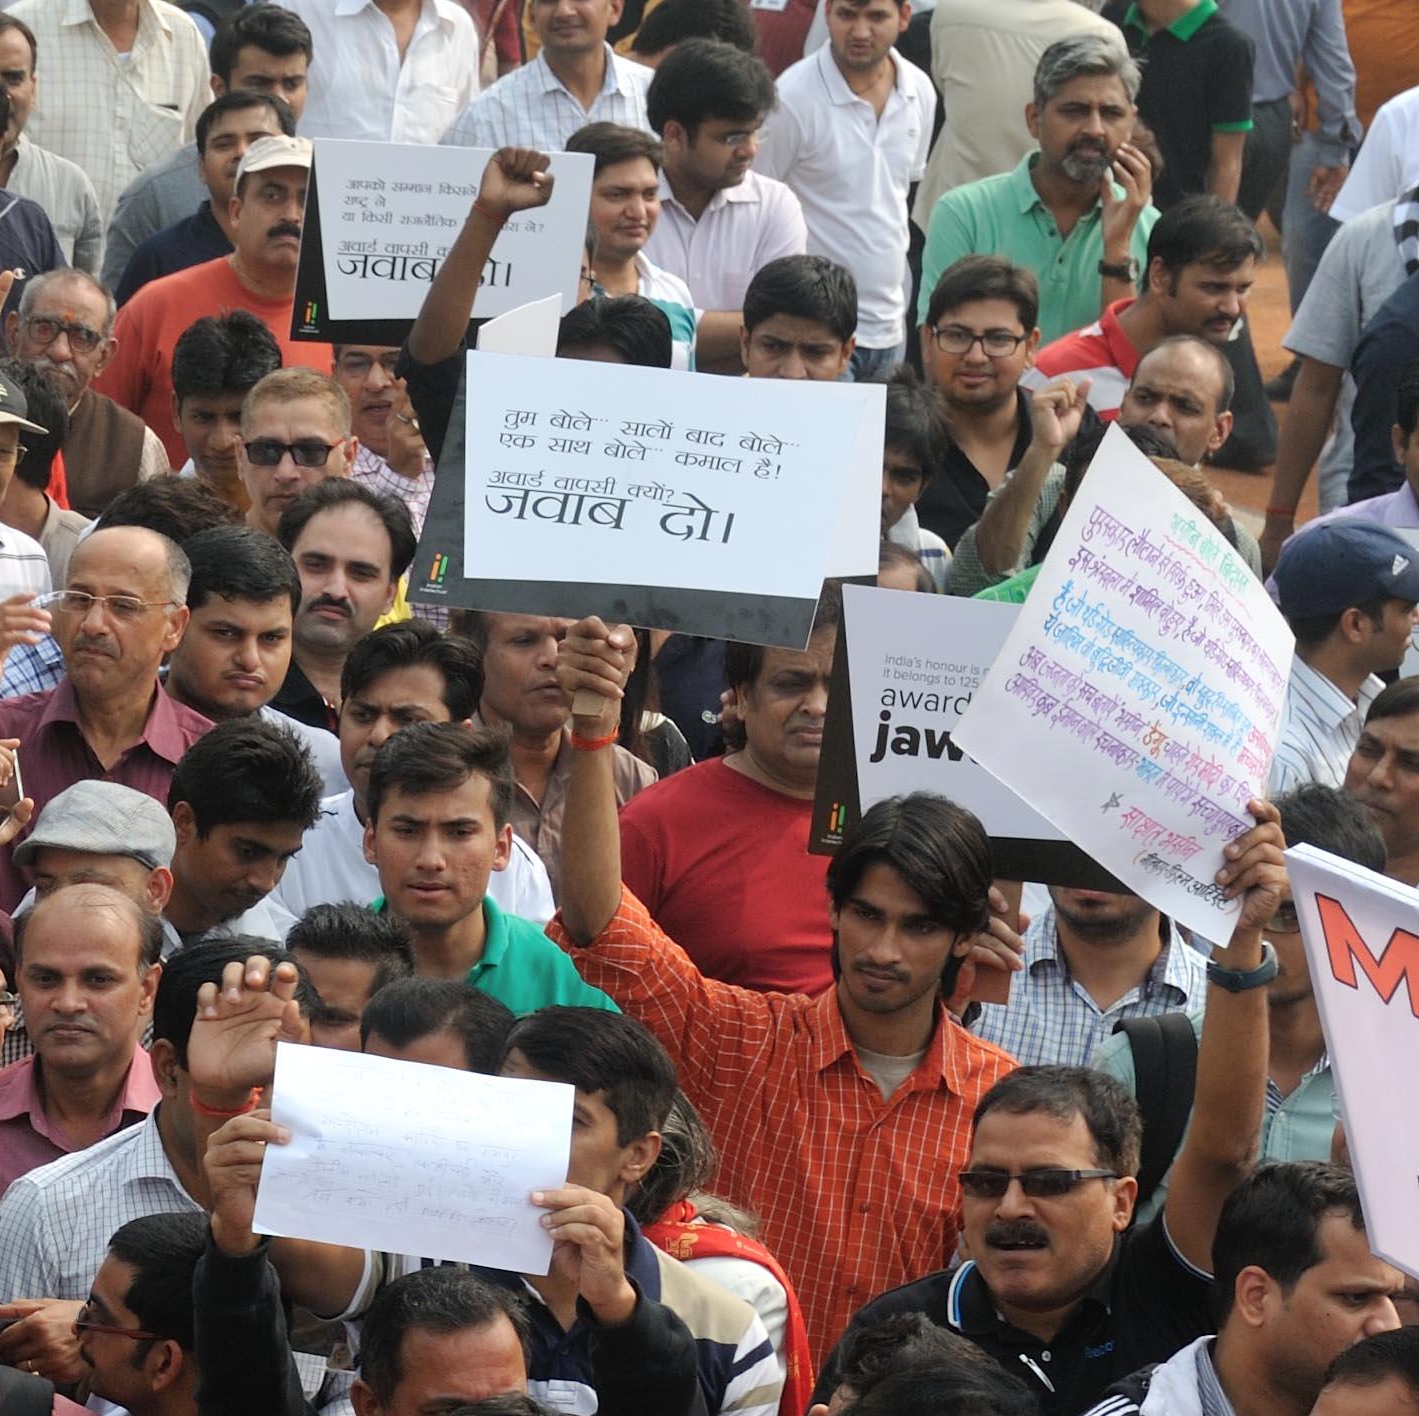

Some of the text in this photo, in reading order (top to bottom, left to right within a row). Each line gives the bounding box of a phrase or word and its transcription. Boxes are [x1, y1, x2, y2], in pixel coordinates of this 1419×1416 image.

[504, 409, 727, 448] तुम सालों बाद
[499, 431, 537, 449] एक
[547, 437, 593, 456] साथ
[675, 450, 744, 474] कमाल
[488, 470, 675, 504] अवार्ड वापसी क्यों?
[485, 485, 736, 544] जवाब दो।
[884, 654, 980, 676] India's honour is
[893, 669, 979, 689] belongs to 125
[881, 688, 972, 715] award
